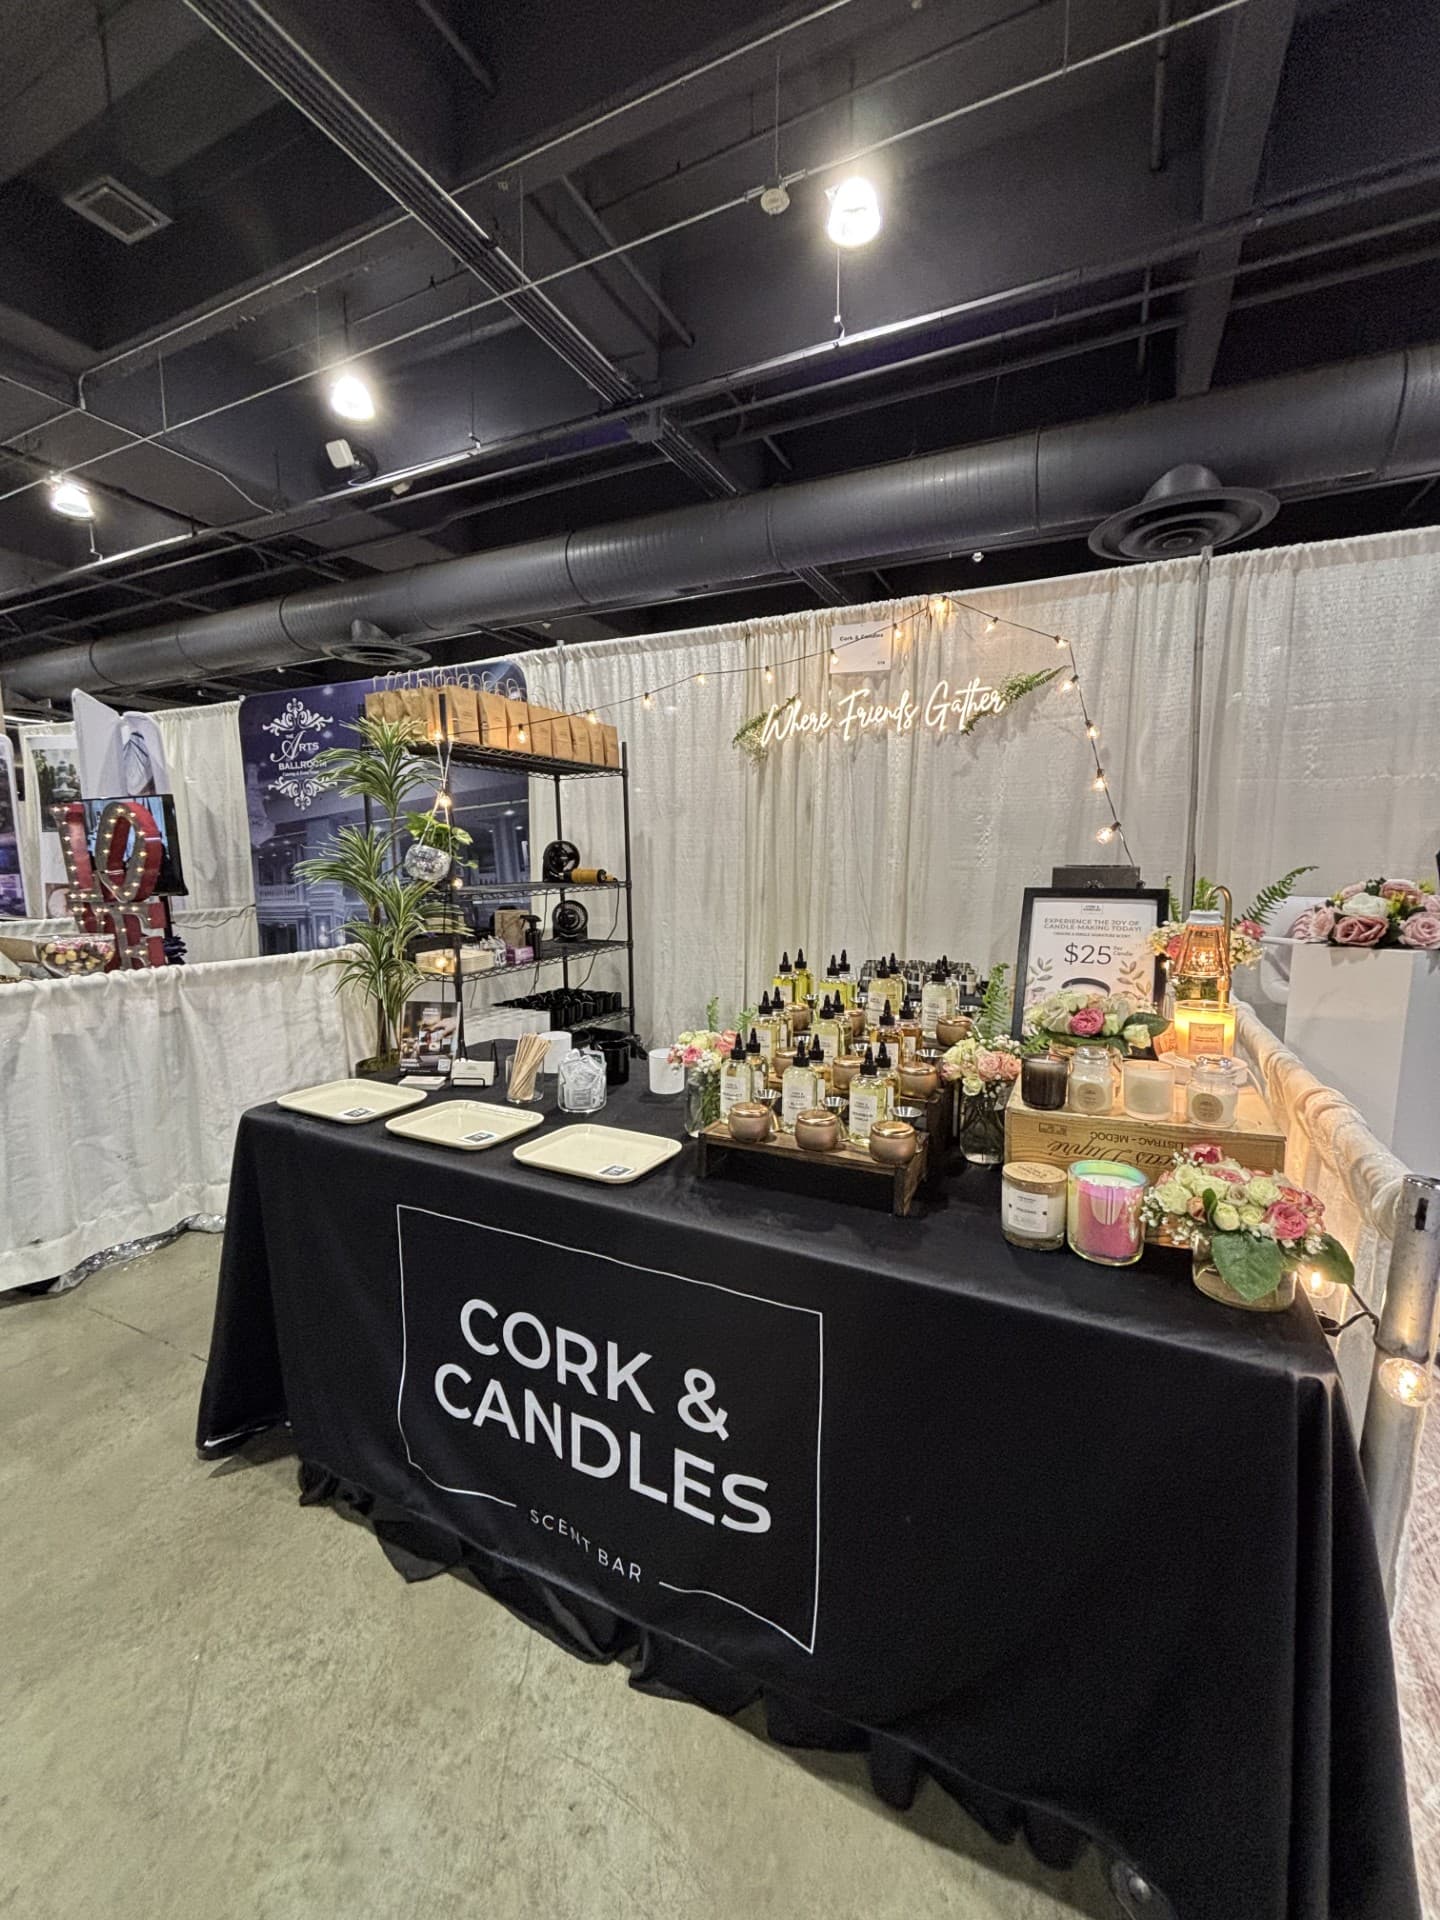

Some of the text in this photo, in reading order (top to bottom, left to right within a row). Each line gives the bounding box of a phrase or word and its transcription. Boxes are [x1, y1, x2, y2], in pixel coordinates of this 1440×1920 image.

[762, 677, 1007, 747] Where Friends Gather
[1044, 917, 1092, 925] EXPERIENCE
[1064, 942, 1112, 966] $25
[1090, 1131, 1129, 1144] MÉDOC
[1138, 1137, 1184, 1150] LISTRAC
[460, 1299, 729, 1441] CORK &
[434, 1363, 772, 1534] CANDLES
[529, 1508, 642, 1583] SCENT BAR
